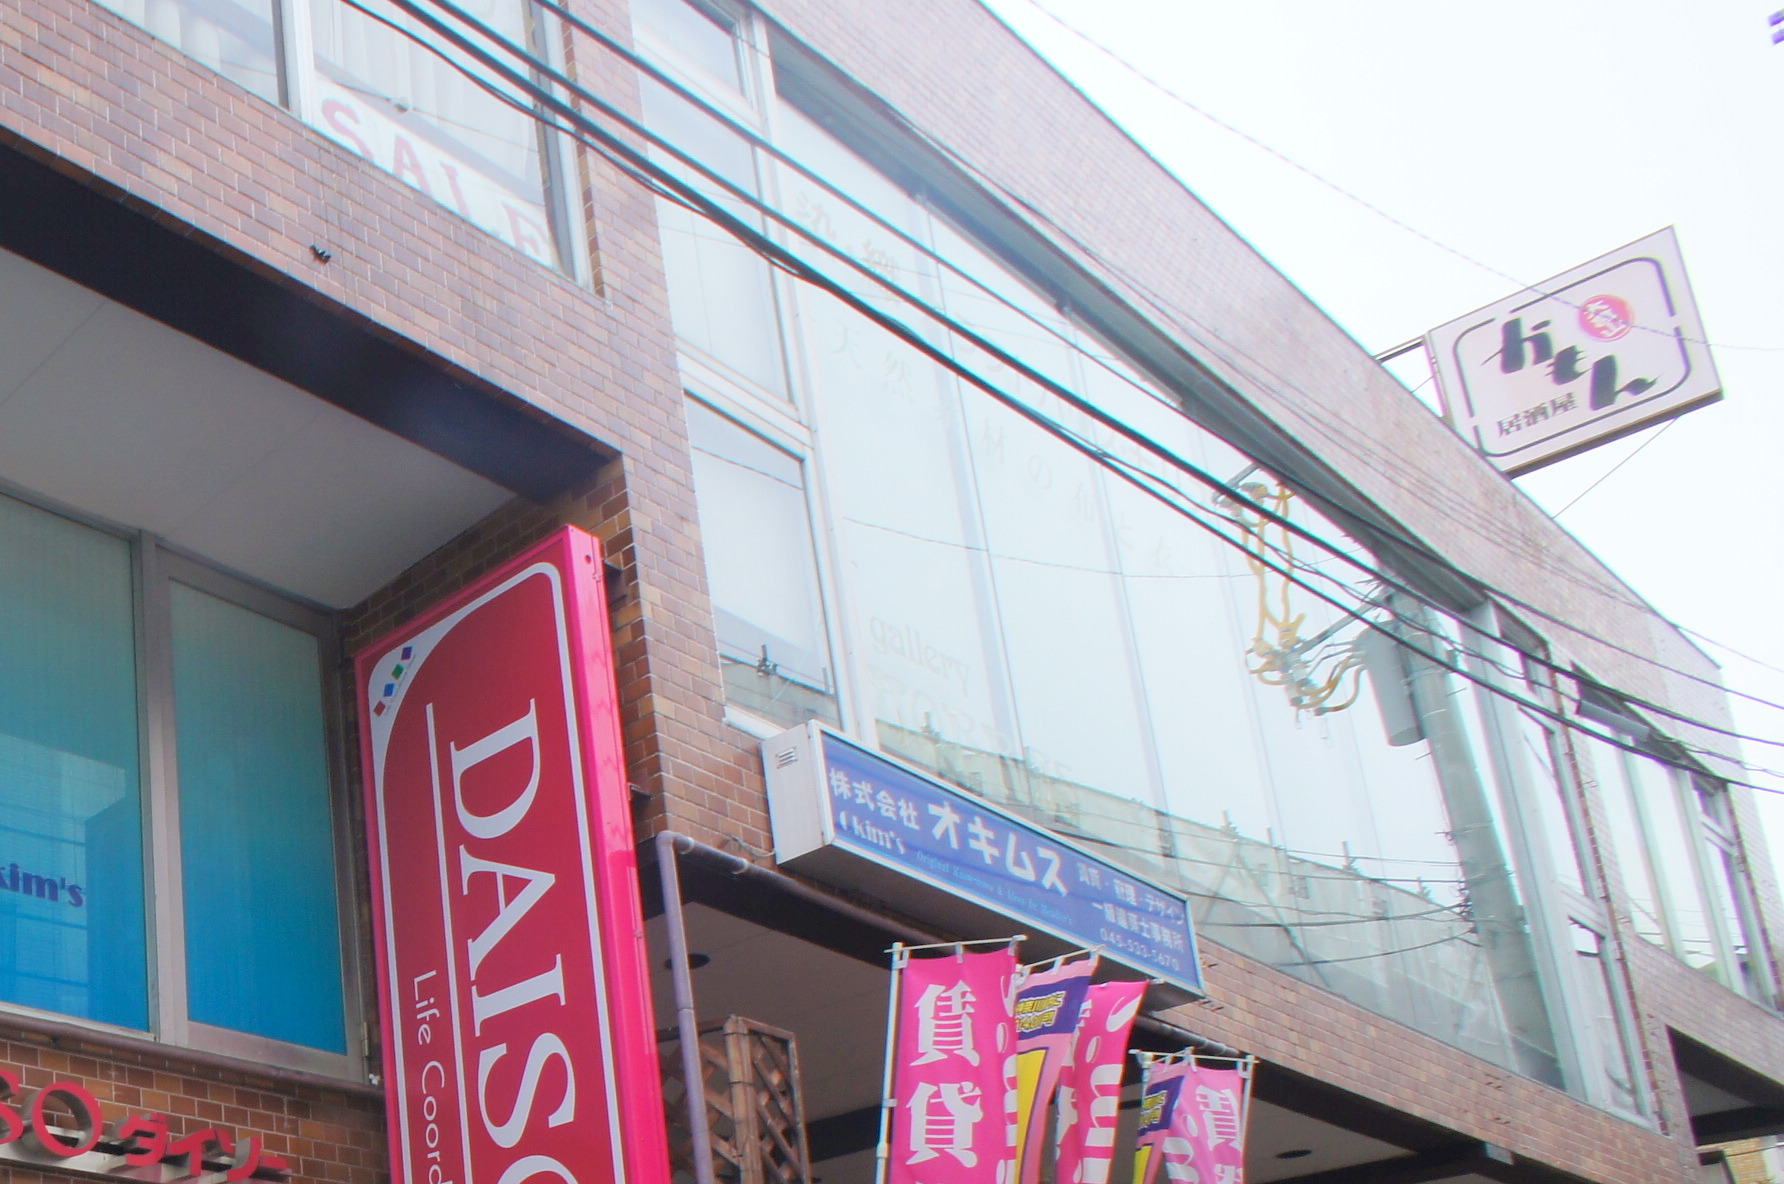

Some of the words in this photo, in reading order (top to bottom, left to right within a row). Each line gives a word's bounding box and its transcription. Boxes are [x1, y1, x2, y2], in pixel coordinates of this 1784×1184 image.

[1497, 391, 1578, 438] 居酒屋
[829, 767, 921, 831] 株式会社
[927, 800, 1069, 898] オキムス
[413, 968, 443, 1046] Life
[117, 1112, 290, 1181] ダイソー
